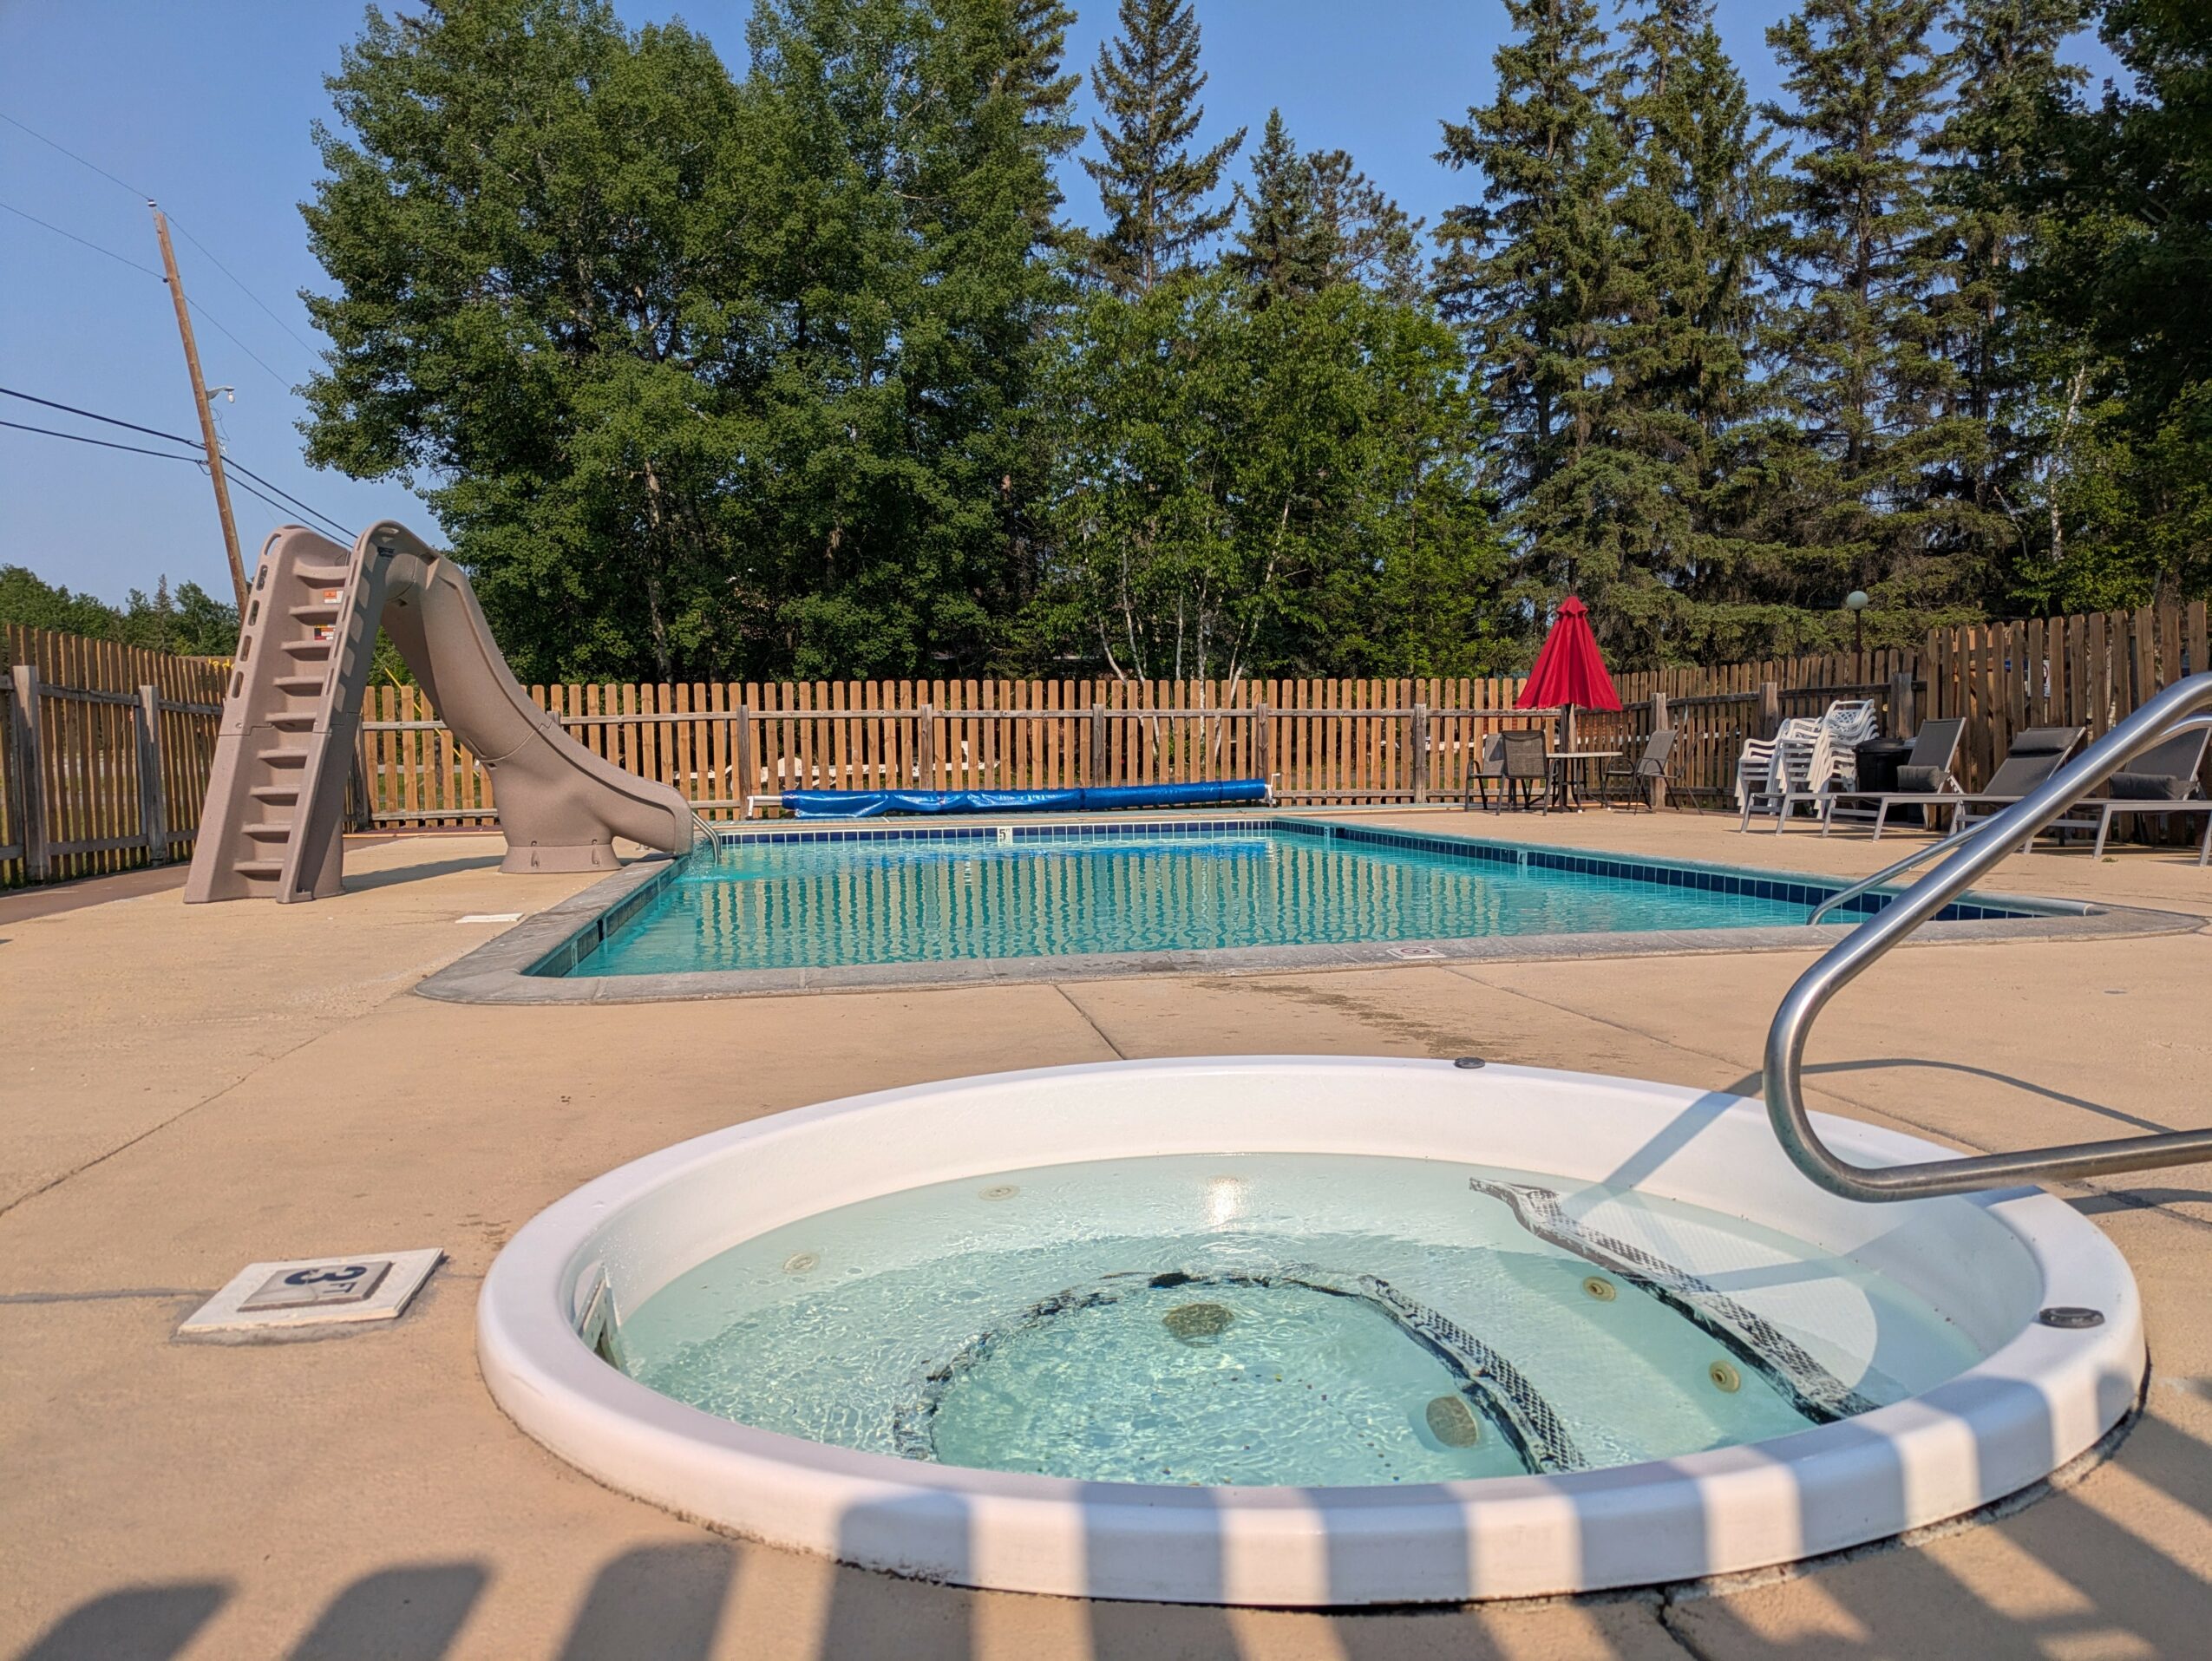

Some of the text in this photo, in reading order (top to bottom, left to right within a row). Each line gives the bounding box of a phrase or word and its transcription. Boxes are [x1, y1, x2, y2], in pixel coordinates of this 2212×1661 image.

[999, 828, 1006, 841] 5
[285, 1265, 368, 1285] 3
[323, 1282, 357, 1294] FT
